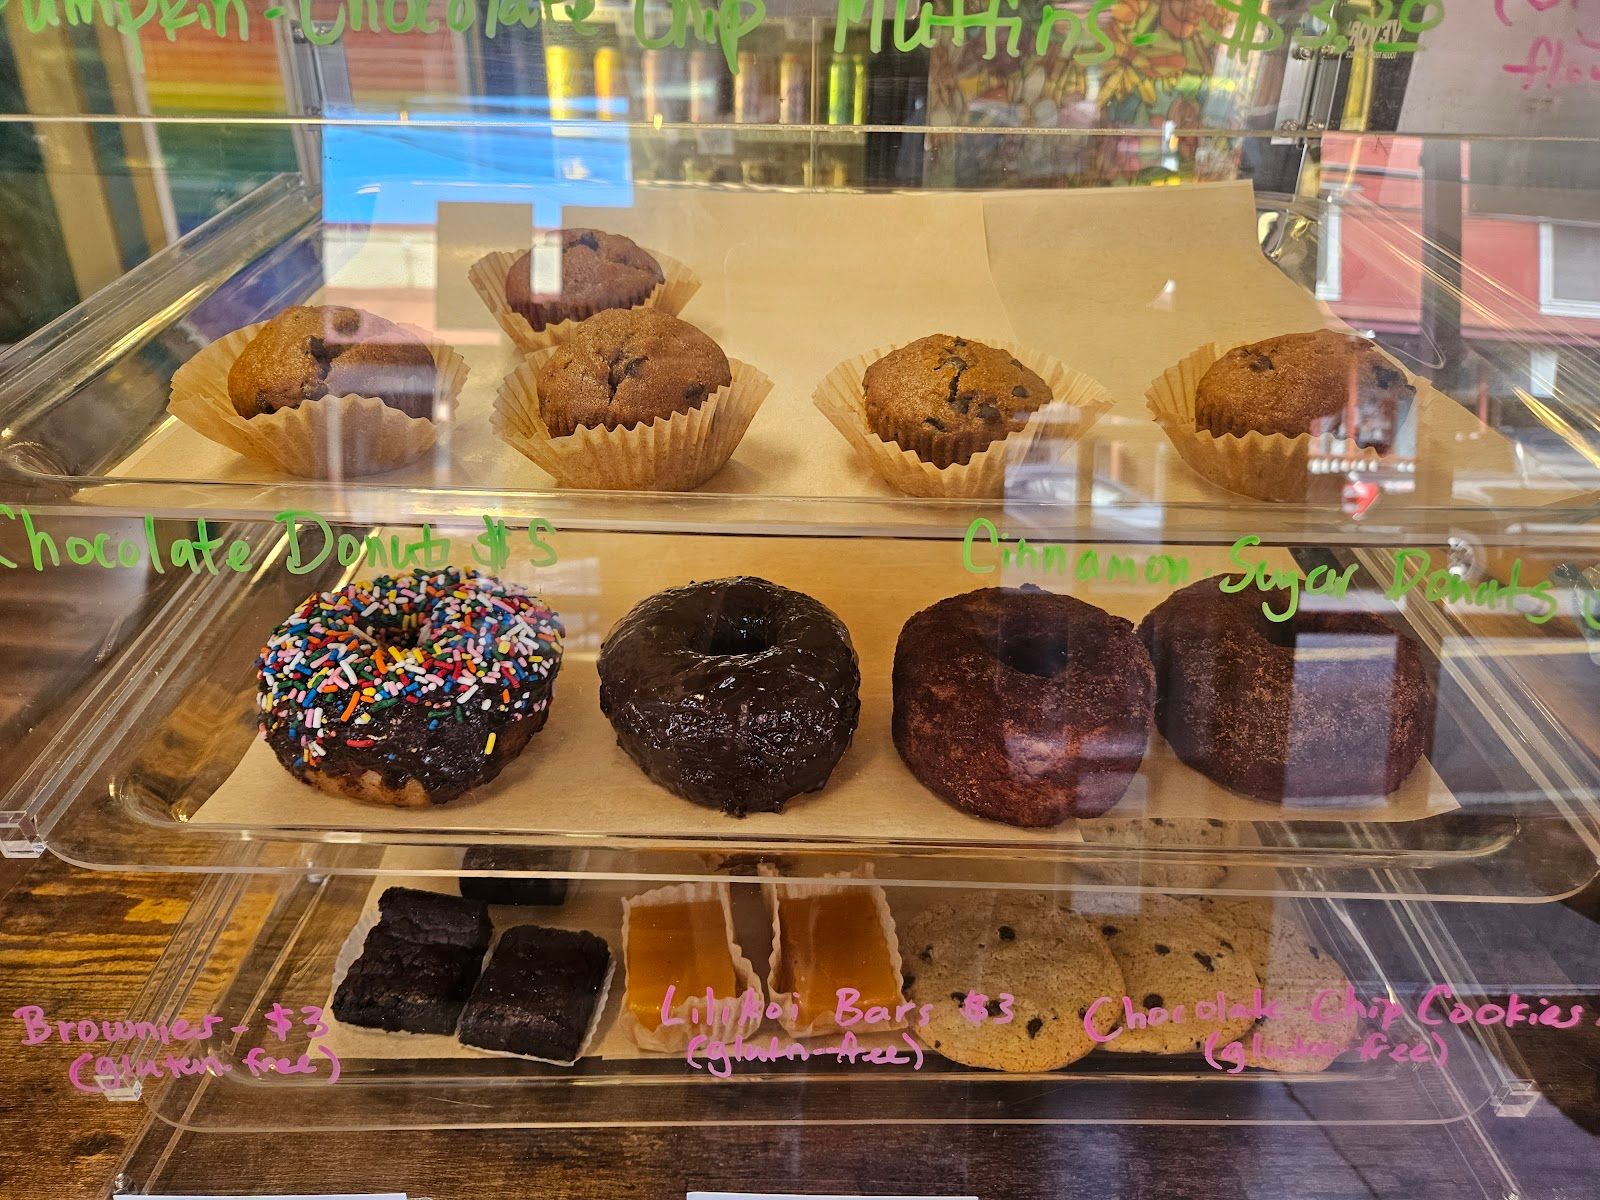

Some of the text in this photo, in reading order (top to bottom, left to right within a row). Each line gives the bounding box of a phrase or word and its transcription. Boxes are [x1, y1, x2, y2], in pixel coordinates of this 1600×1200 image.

[0, 0, 249, 74] umpkin
[963, 517, 1190, 585] Cinnamon
[1219, 535, 1358, 622] Sugar
[1384, 547, 1557, 624] Donuts
[13, 1005, 223, 1045] Brownies
[265, 1003, 329, 1041] $3
[661, 985, 1015, 1026] Lilikoi Bars $3
[1311, 984, 1402, 1030] Chip
[1417, 984, 1584, 1028] Cookies
